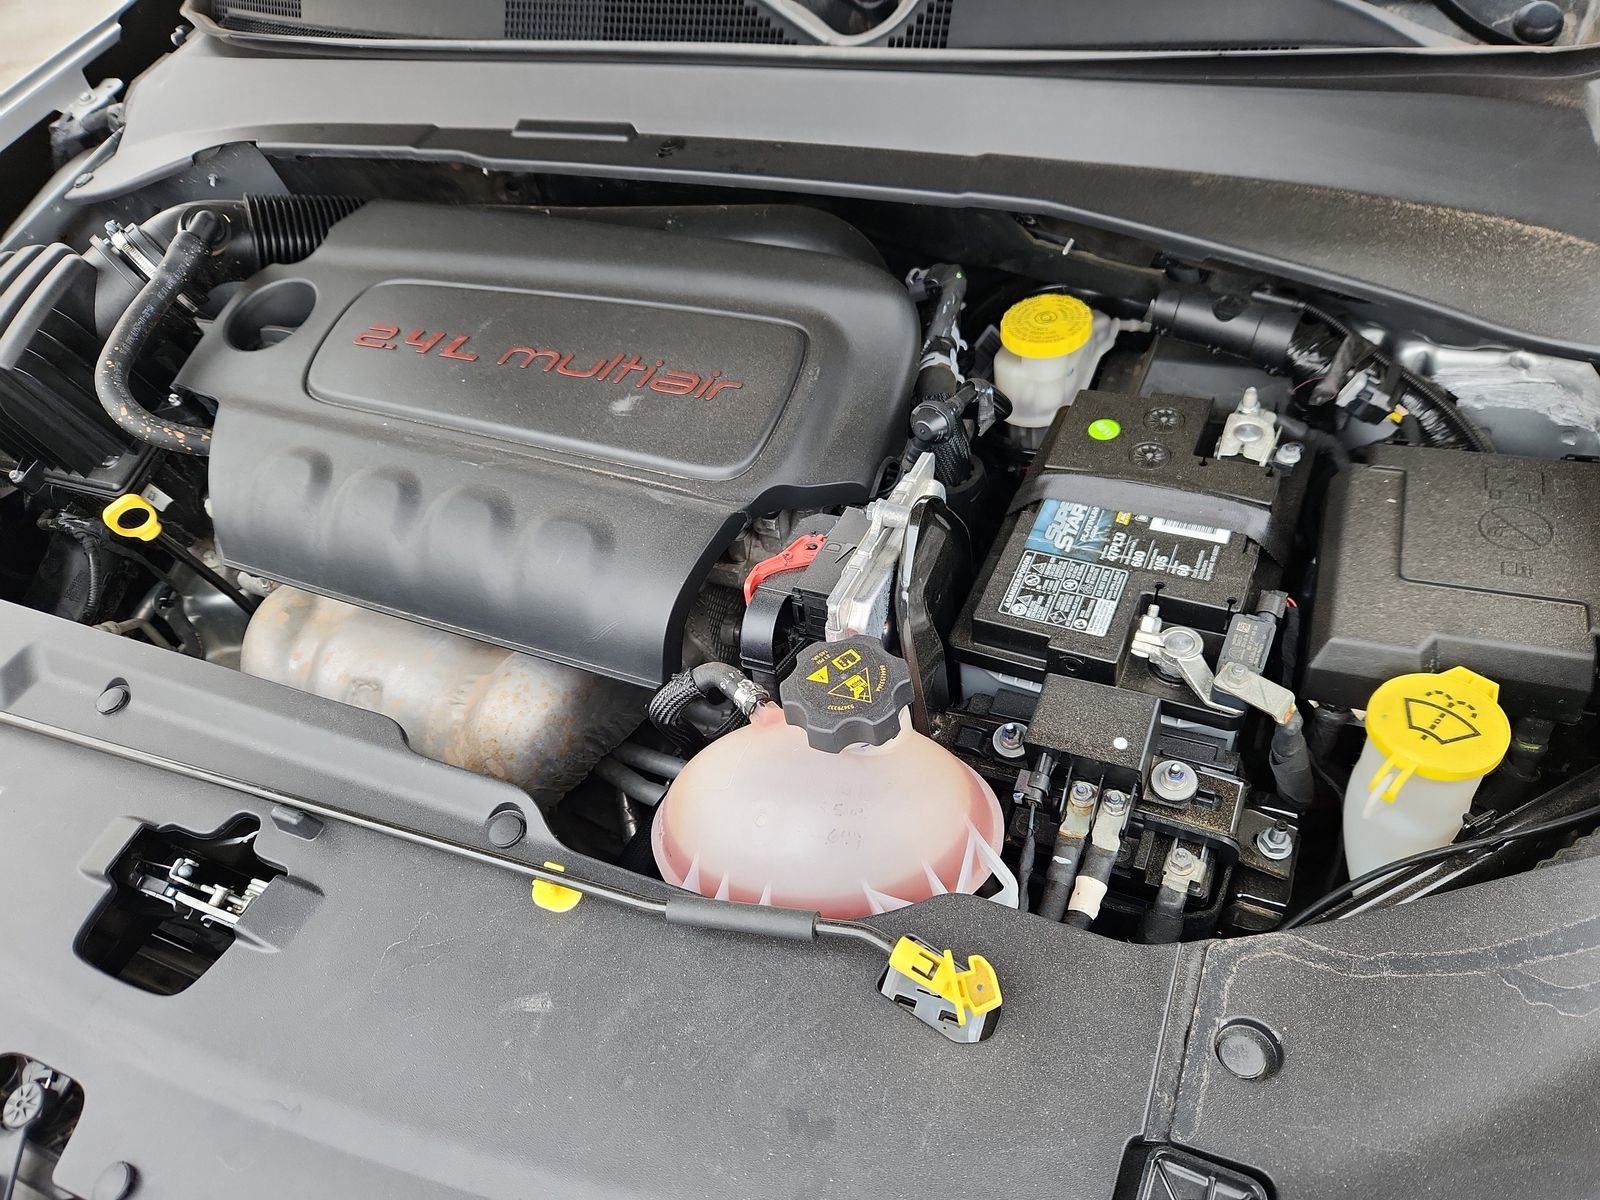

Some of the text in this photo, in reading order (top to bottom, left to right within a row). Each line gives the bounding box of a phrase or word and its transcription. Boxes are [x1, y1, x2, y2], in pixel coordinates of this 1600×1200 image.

[353, 324, 744, 402] 2.4L multiair
[1080, 507, 1100, 542] PLATINUM
[1131, 550, 1147, 567] 680
[1154, 555, 1169, 571] 105
[1177, 564, 1191, 577] 60
